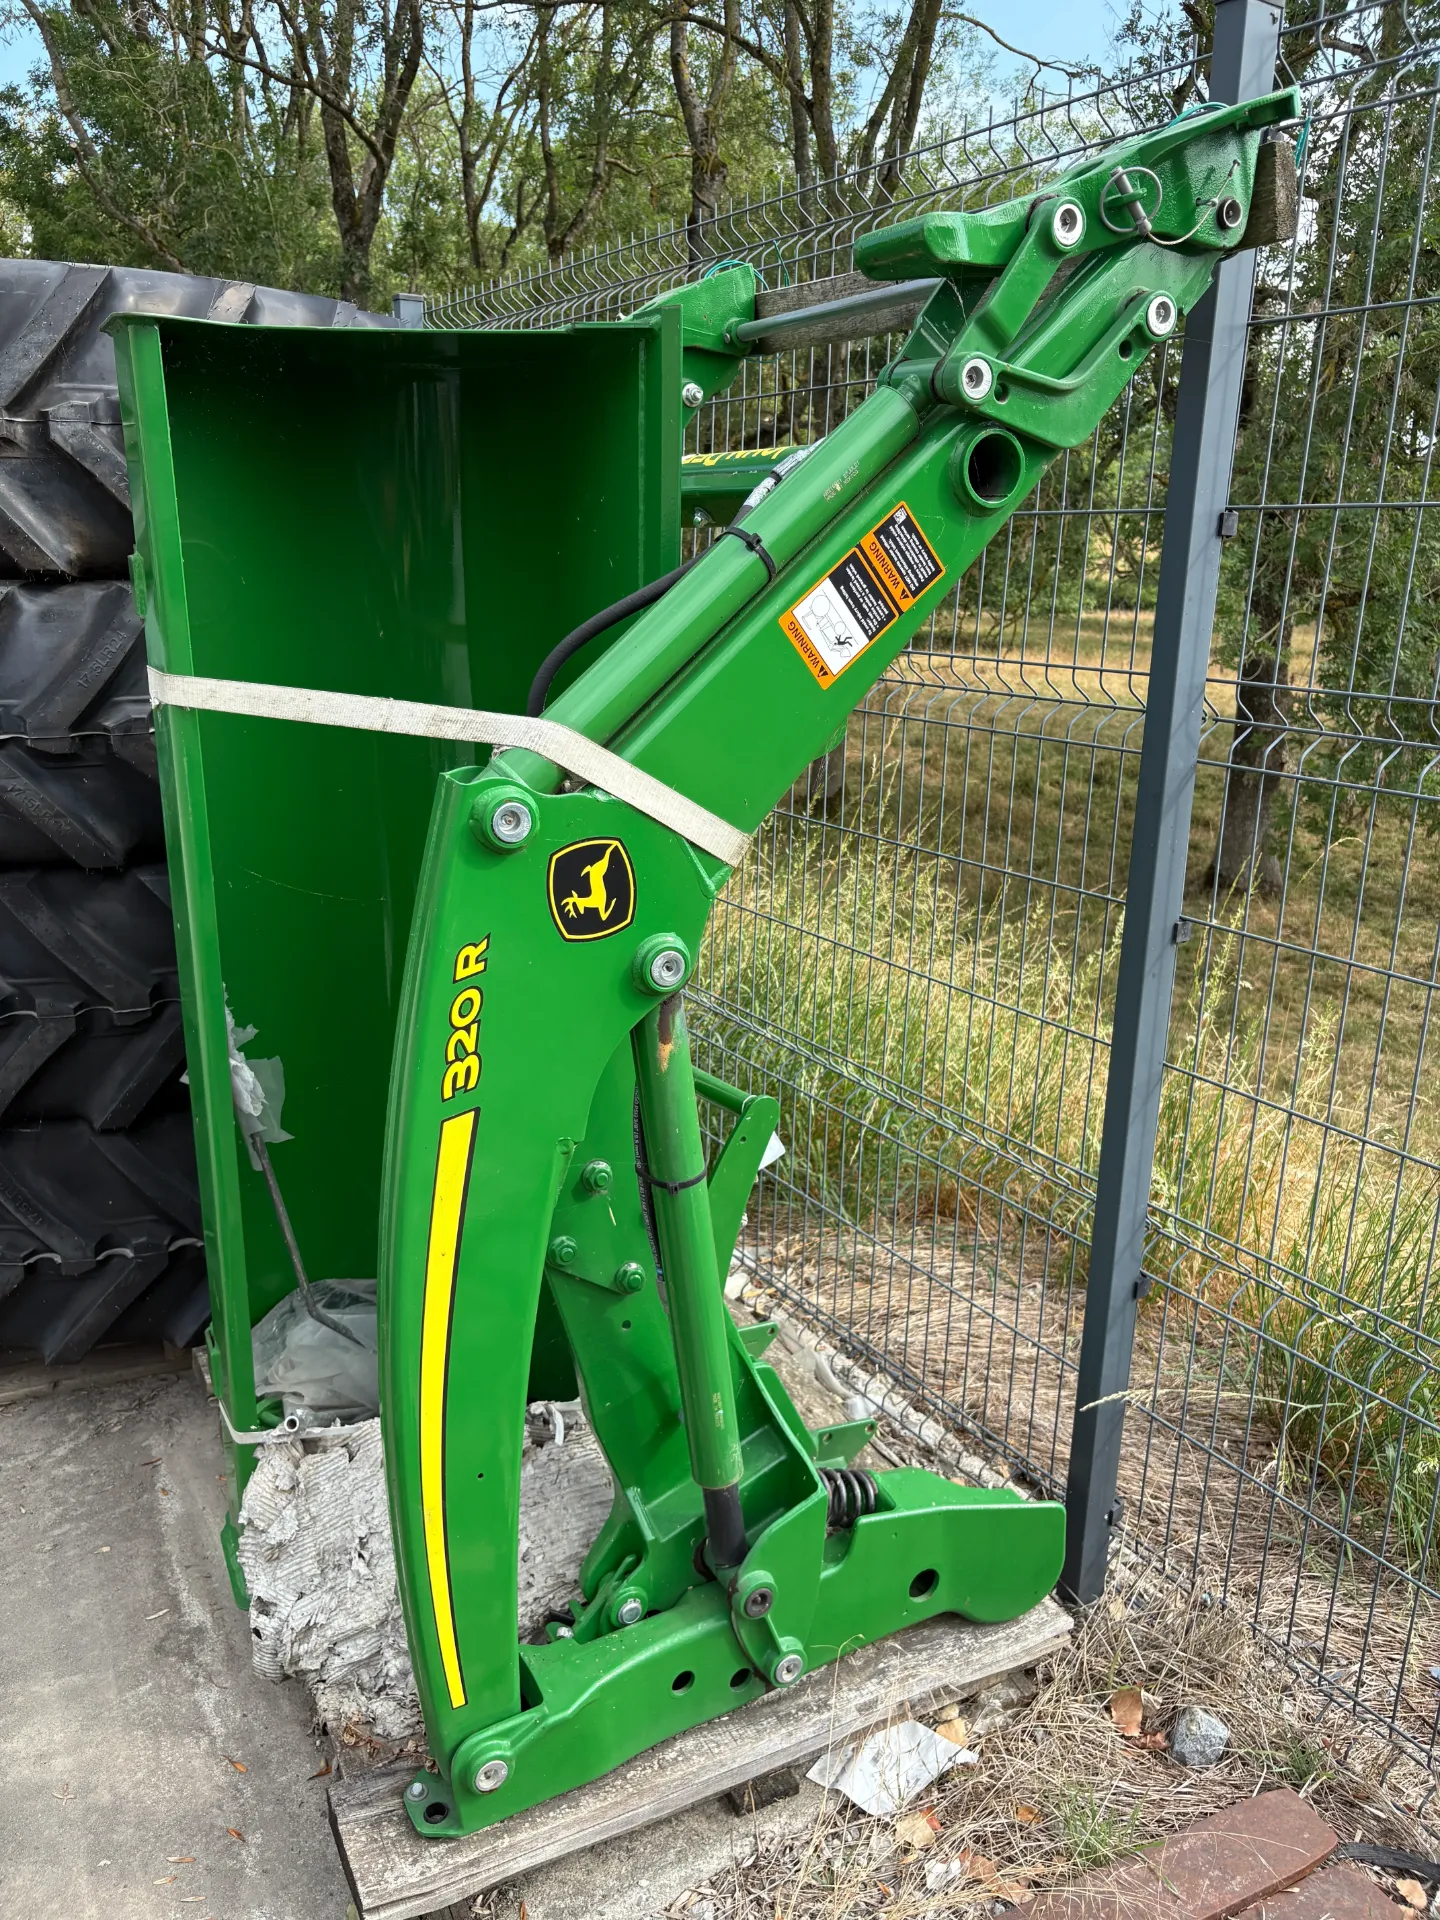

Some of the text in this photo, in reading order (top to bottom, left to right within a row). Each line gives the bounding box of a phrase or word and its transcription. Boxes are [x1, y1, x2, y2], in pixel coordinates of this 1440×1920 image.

[869, 541, 900, 589] WARNING
[788, 621, 820, 668] WARNING
[441, 932, 491, 1103] 320R
